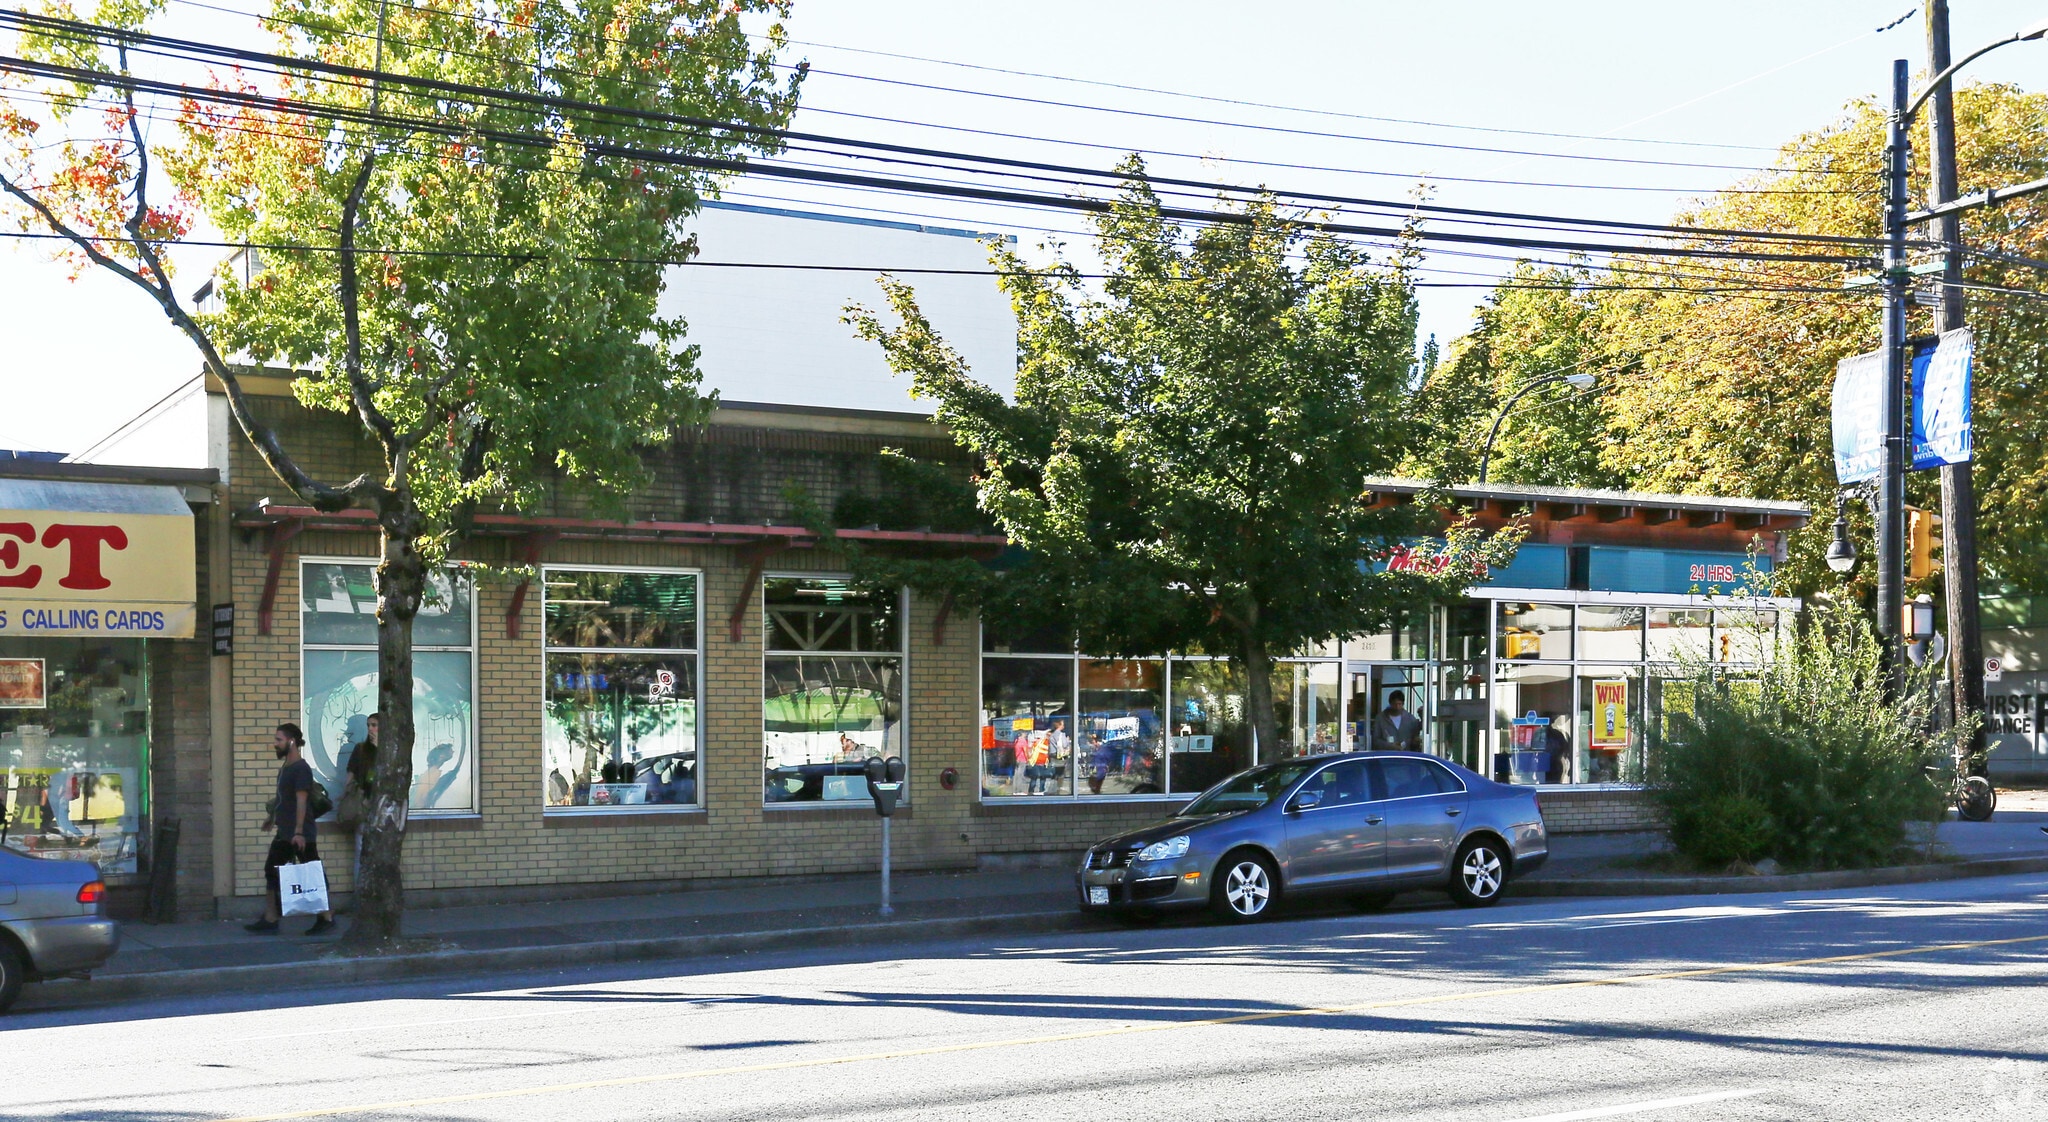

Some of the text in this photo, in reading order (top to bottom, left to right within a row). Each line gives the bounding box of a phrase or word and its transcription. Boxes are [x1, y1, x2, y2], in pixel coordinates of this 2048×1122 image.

[1690, 564, 1705, 581] 24
[22, 608, 99, 630] CALLING
[104, 610, 165, 631] CARDS
[1595, 685, 1625, 705] WIN!
[1984, 694, 2032, 715] IRST
[1984, 718, 2031, 734] VANCE
